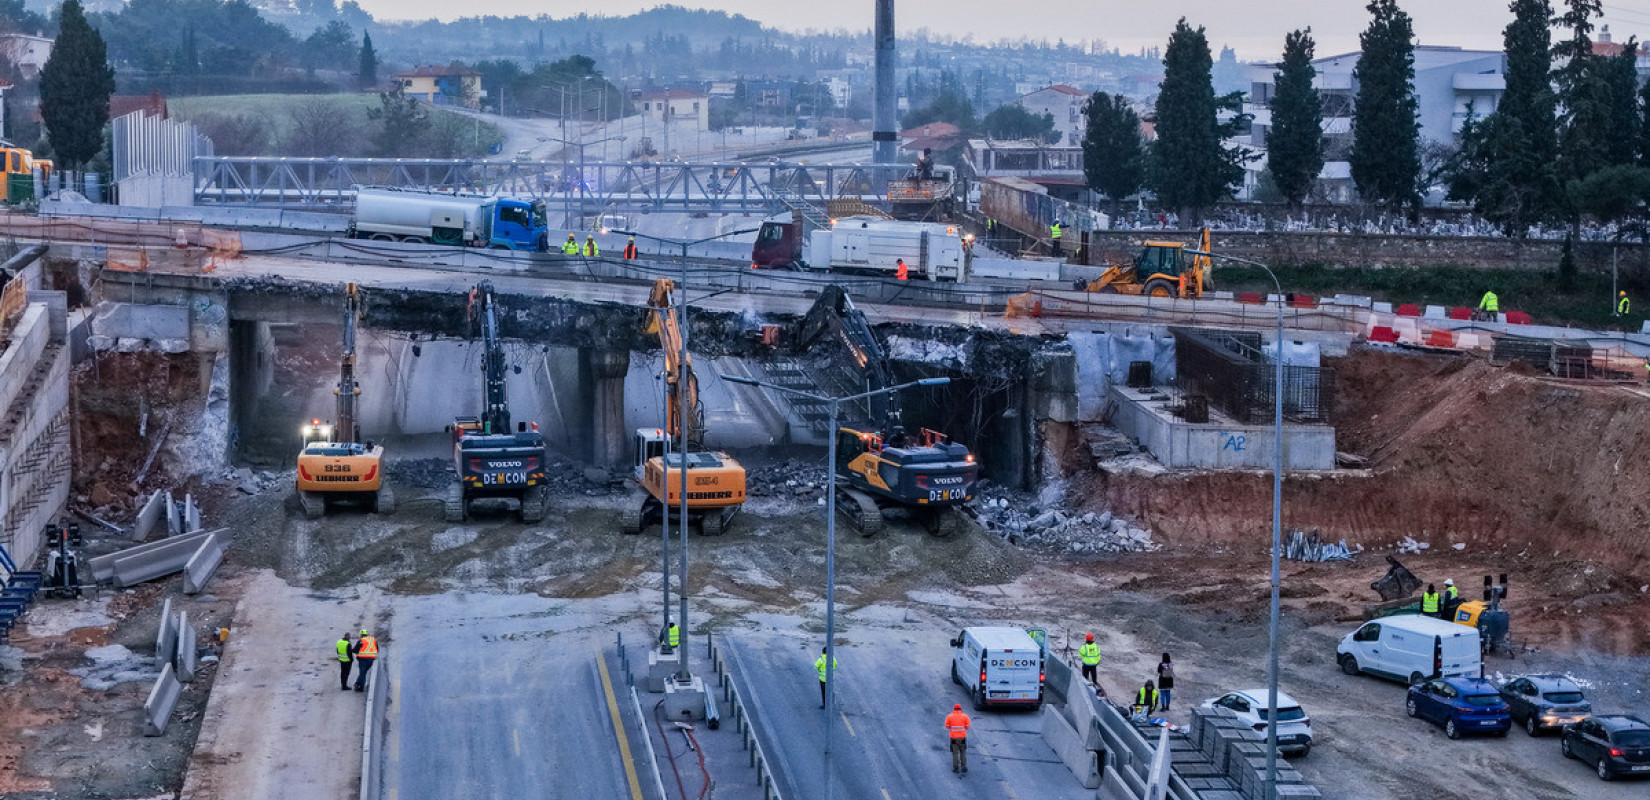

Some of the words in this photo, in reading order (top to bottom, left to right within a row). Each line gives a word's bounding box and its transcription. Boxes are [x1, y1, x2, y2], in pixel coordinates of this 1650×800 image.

[1223, 435, 1246, 451] A2
[483, 472, 527, 485] DEMCON
[934, 476, 963, 485] VOLVO
[929, 488, 967, 502] DEMCON
[991, 659, 1036, 667] DEMCON
